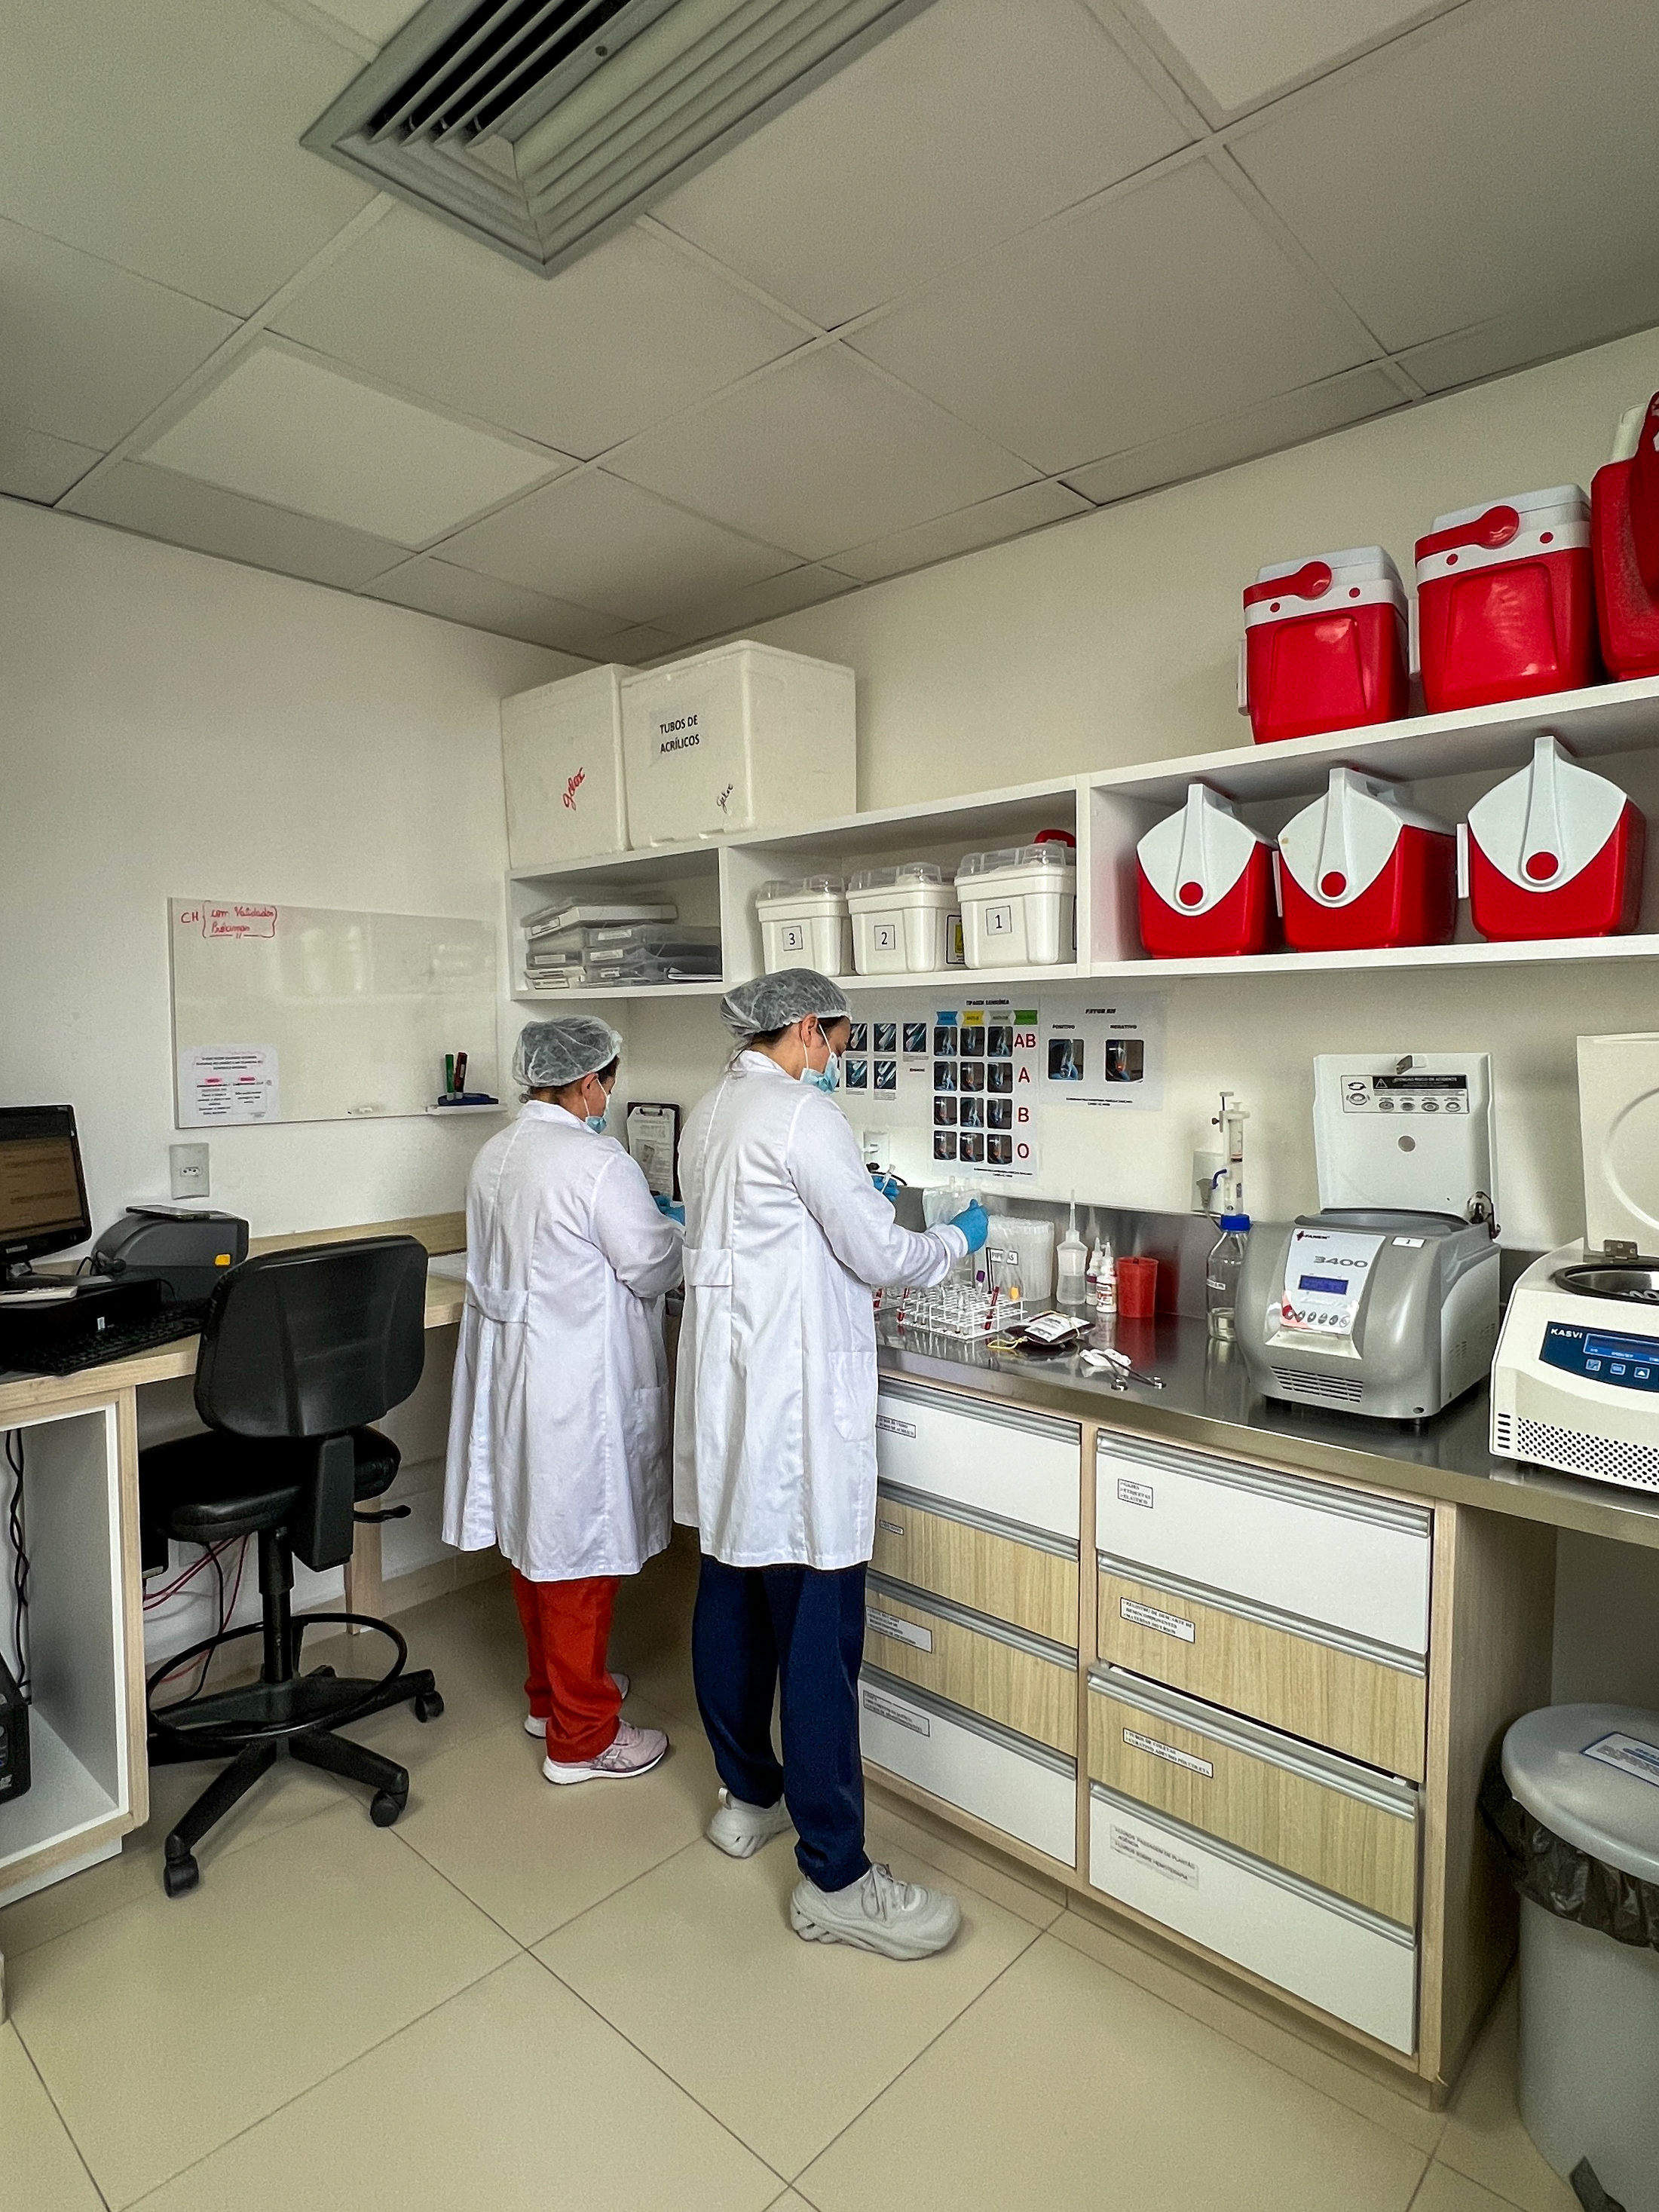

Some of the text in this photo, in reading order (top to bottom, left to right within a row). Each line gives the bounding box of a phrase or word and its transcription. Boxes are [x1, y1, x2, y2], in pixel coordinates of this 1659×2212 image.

[660, 714, 698, 734] TUBOS DE
[660, 734, 699, 754] ACRÍLICOS
[181, 911, 198, 923] CH
[995, 914, 1002, 929] 1
[788, 932, 796, 945] 3
[881, 932, 888, 945] 2
[1015, 1033, 1036, 1048] AB
[1018, 1067, 1030, 1083] A
[1018, 1107, 1030, 1122] B
[1018, 1143, 1029, 1158] O
[1313, 1256, 1368, 1268] 3400
[1550, 1328, 1583, 1339] KASVI
